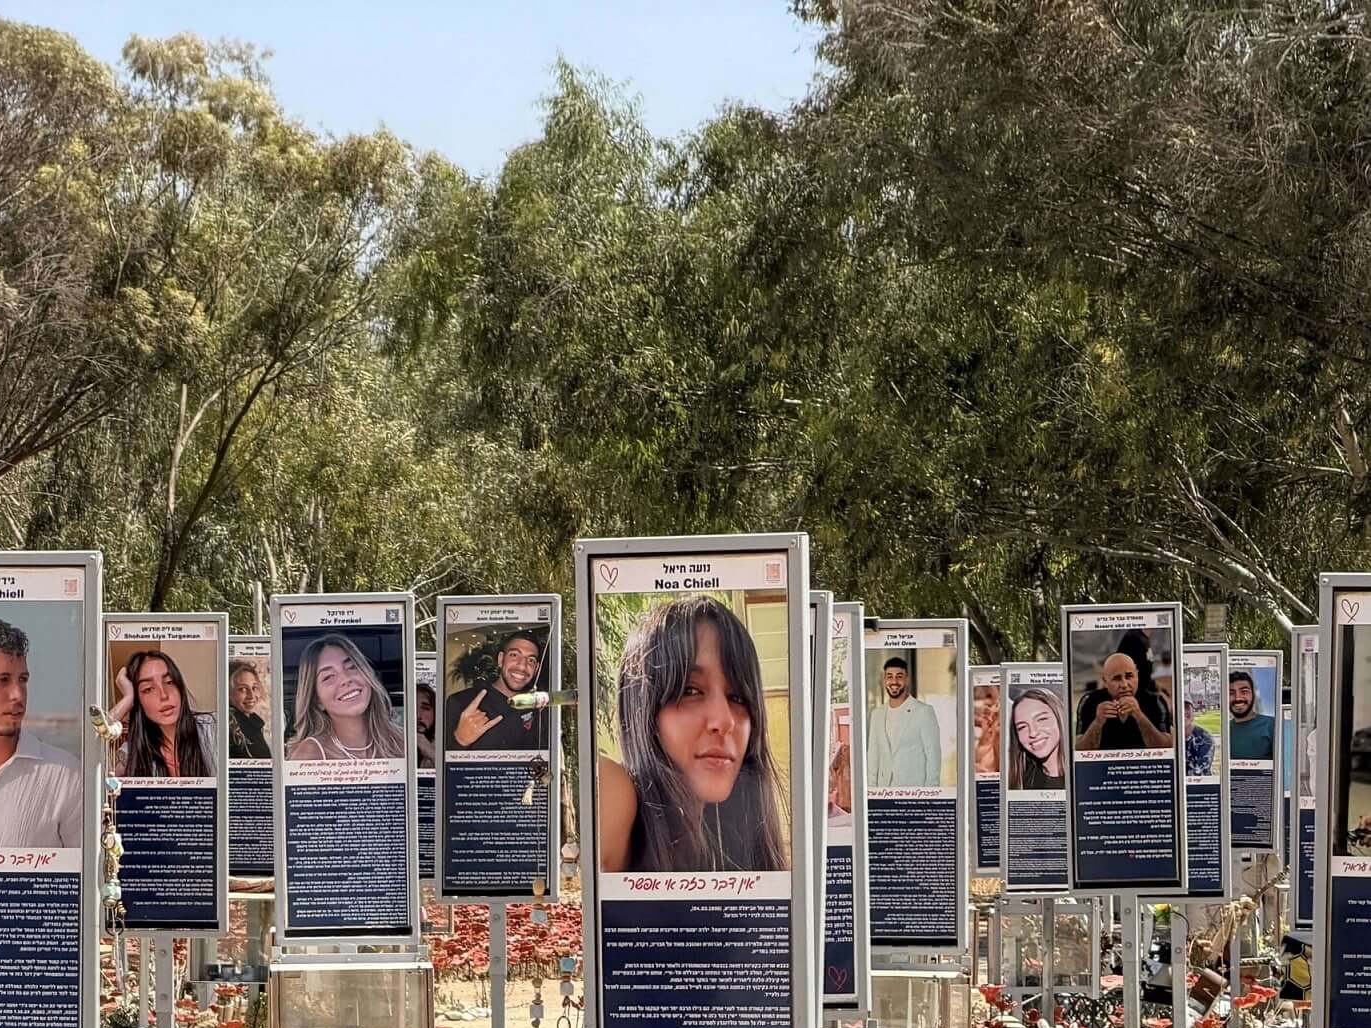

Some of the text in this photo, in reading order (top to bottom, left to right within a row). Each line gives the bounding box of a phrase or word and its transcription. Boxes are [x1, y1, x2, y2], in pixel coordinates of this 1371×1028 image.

[663, 563, 711, 574] נועה חיאל
[655, 578, 719, 589] Noa Chiell
[10, 853, 34, 865] דבר
[664, 878, 675, 890] אי
[679, 877, 706, 891] כזה
[712, 877, 737, 890] דבר
